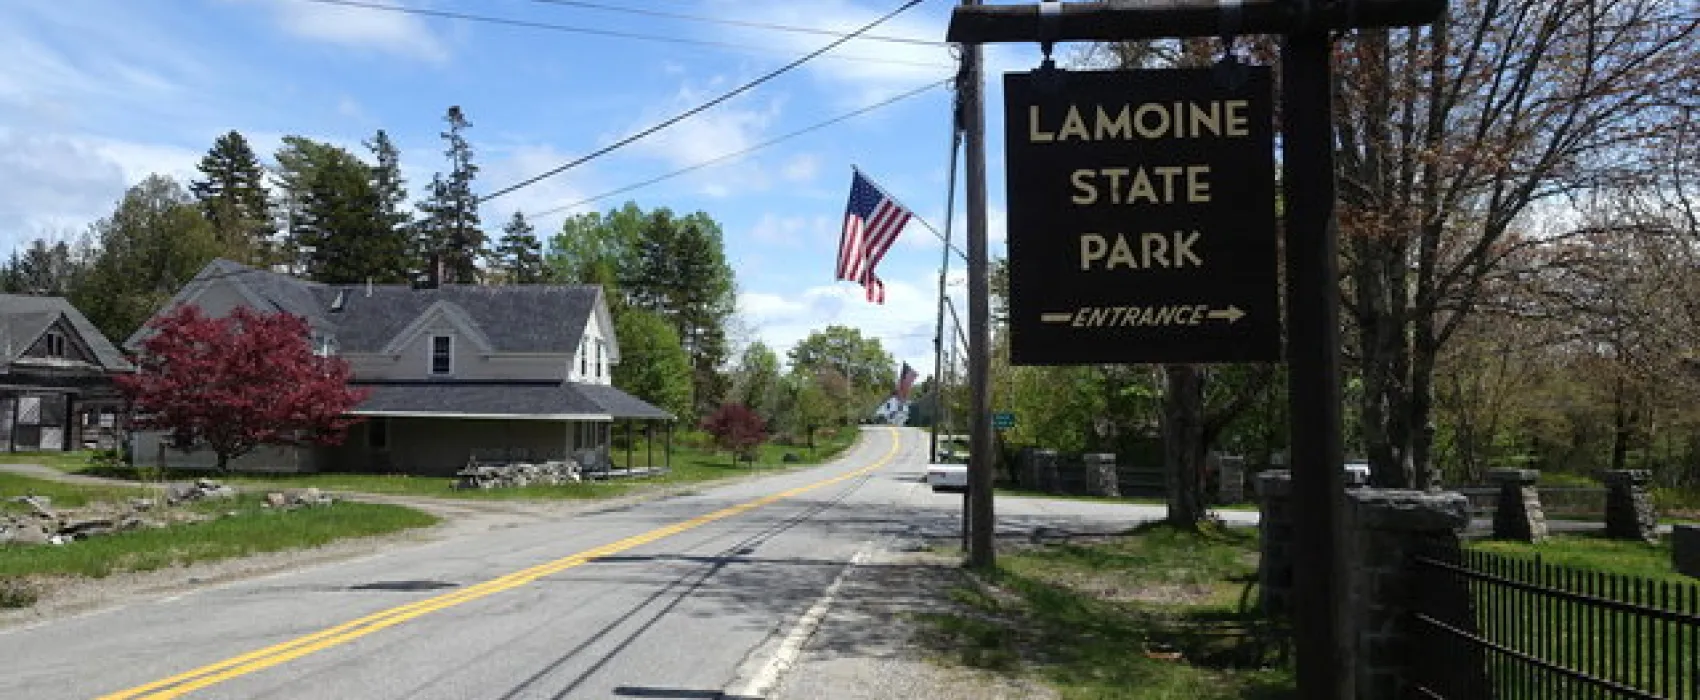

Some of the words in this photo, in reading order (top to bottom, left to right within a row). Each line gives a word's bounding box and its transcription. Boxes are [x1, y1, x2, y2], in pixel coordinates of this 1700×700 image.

[1029, 100, 1249, 142] LAMOINE
[1070, 164, 1212, 205] STATE
[1080, 230, 1203, 271] PARK
[1072, 304, 1209, 327] ENTRANCE
